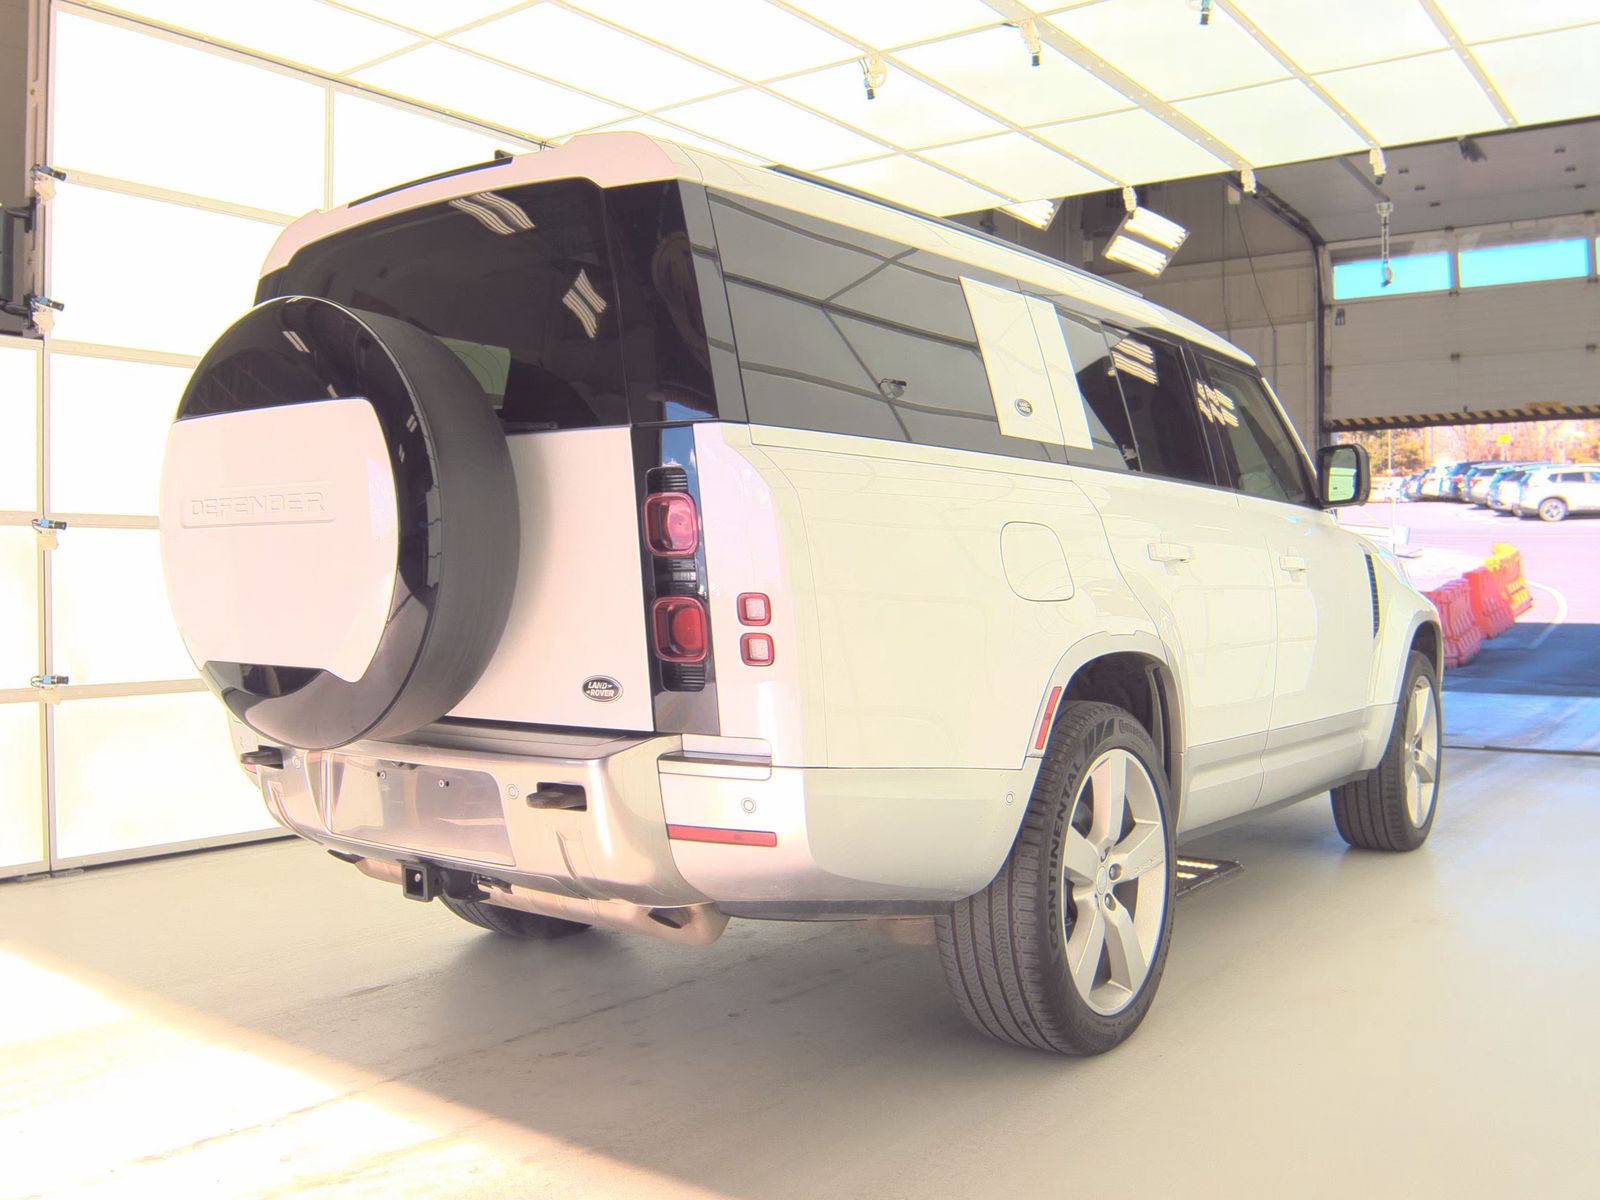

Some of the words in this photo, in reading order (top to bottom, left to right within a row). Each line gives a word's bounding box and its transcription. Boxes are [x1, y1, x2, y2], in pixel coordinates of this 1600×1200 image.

[190, 491, 325, 517] DEFENDER
[588, 681, 608, 690] LAND
[590, 689, 615, 697] ROVER
[1048, 761, 1083, 950] CONTINENTAL
